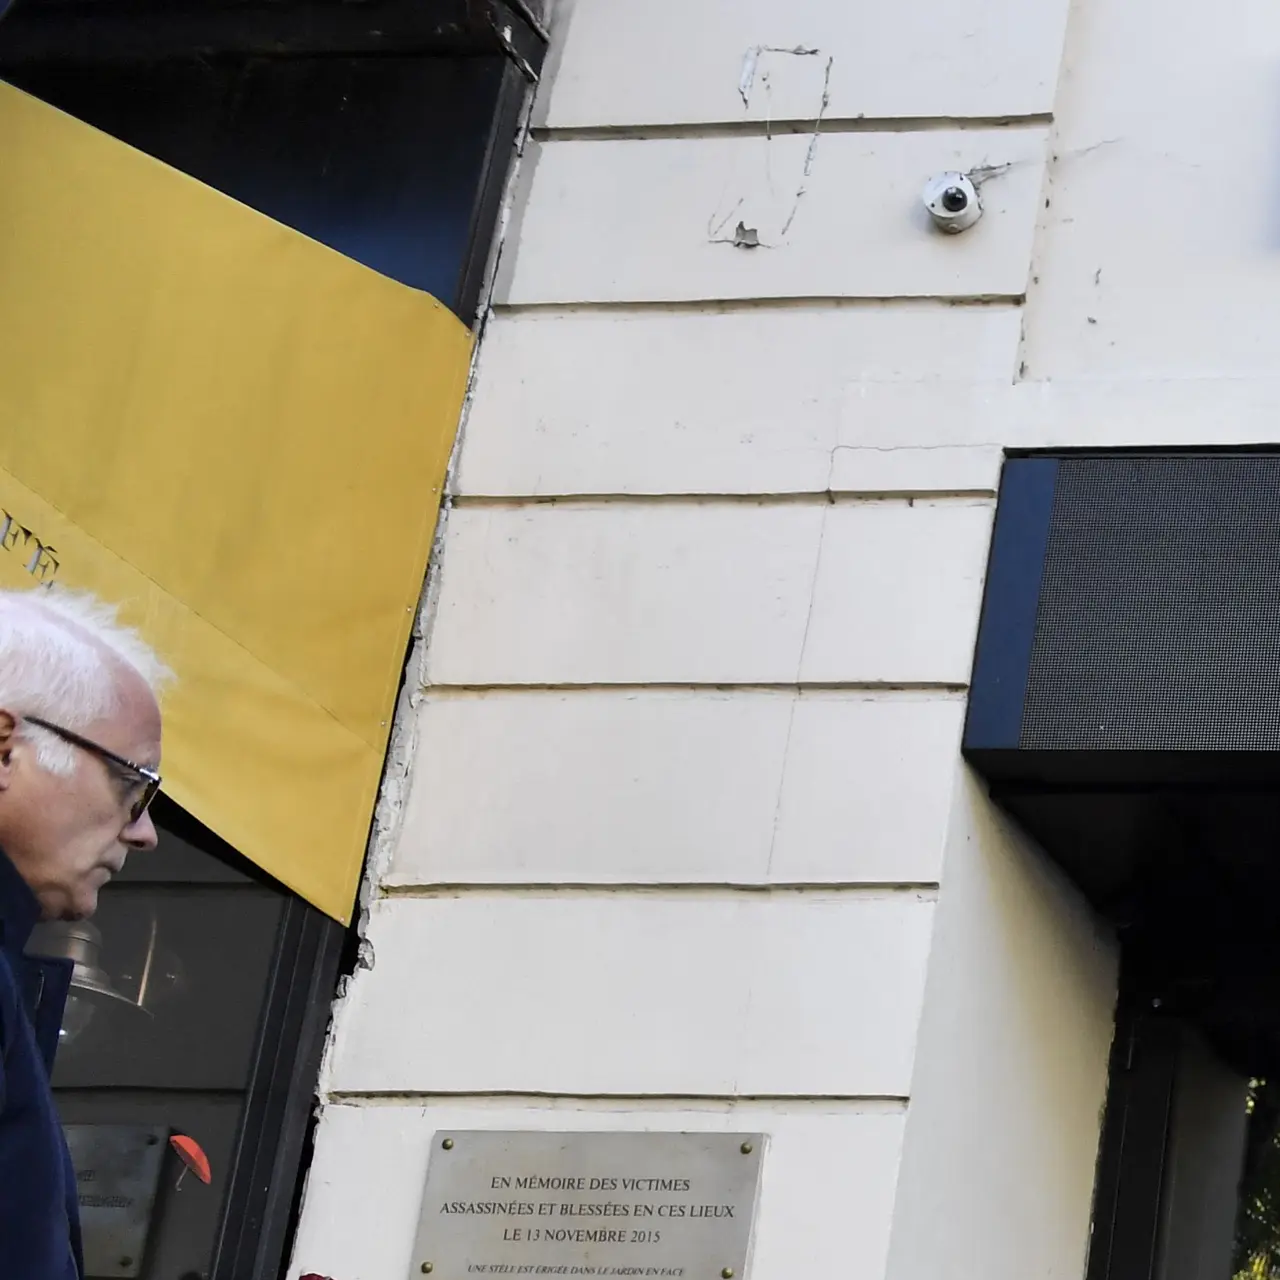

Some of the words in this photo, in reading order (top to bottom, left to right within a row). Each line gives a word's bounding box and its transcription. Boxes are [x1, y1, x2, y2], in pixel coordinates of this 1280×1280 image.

[491, 1176, 512, 1189] EN
[515, 1174, 585, 1190] MÉMOIRE
[590, 1178, 617, 1191] DES
[622, 1178, 690, 1191] VICTIMES
[440, 1200, 534, 1215] ASSASSINÉES
[538, 1203, 556, 1216] ET
[560, 1201, 630, 1217] BLESSÉES
[633, 1204, 654, 1217] EN
[657, 1205, 686, 1218] CES
[690, 1205, 735, 1218] LIEUX
[503, 1228, 522, 1241] LE
[527, 1228, 541, 1241] 13
[544, 1229, 627, 1242] NOVEMBRE
[630, 1230, 661, 1243] 2015
